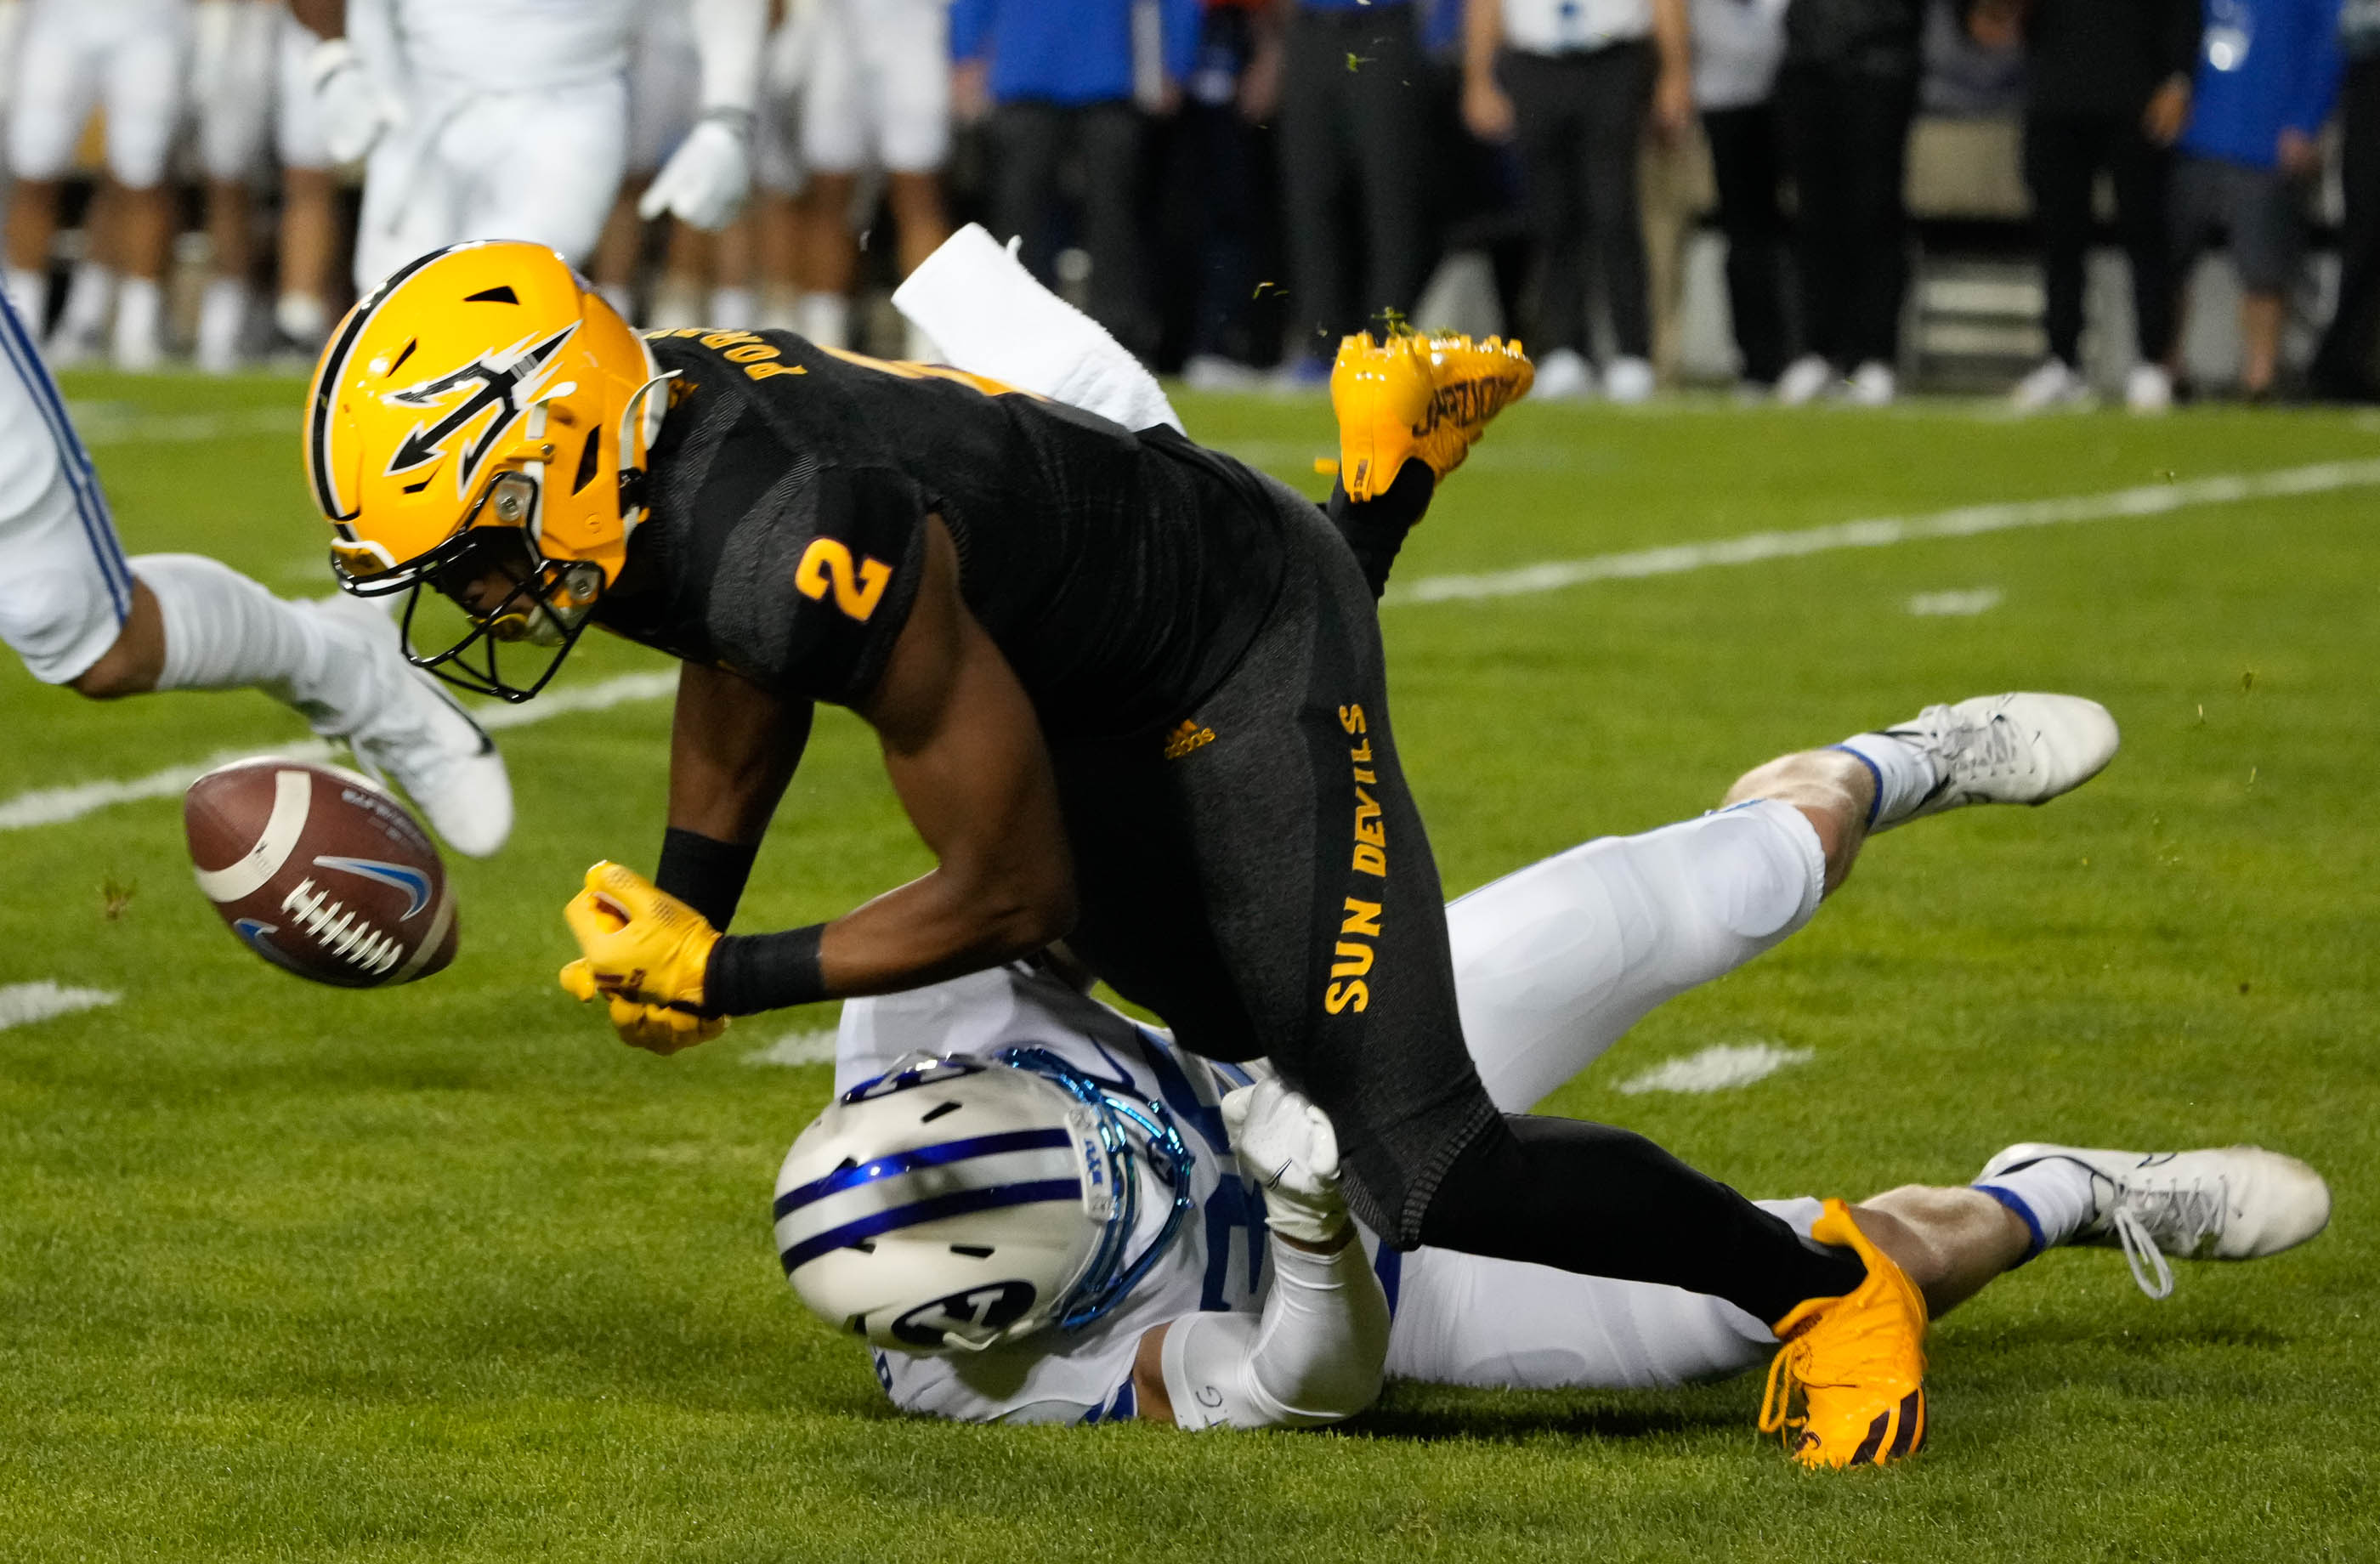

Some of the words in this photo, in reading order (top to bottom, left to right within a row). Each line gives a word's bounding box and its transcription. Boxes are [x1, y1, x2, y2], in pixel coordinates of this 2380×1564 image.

[795, 537, 892, 622] 2
[1339, 704, 1386, 878] DEVILS
[1324, 897, 1382, 1015] SUN
